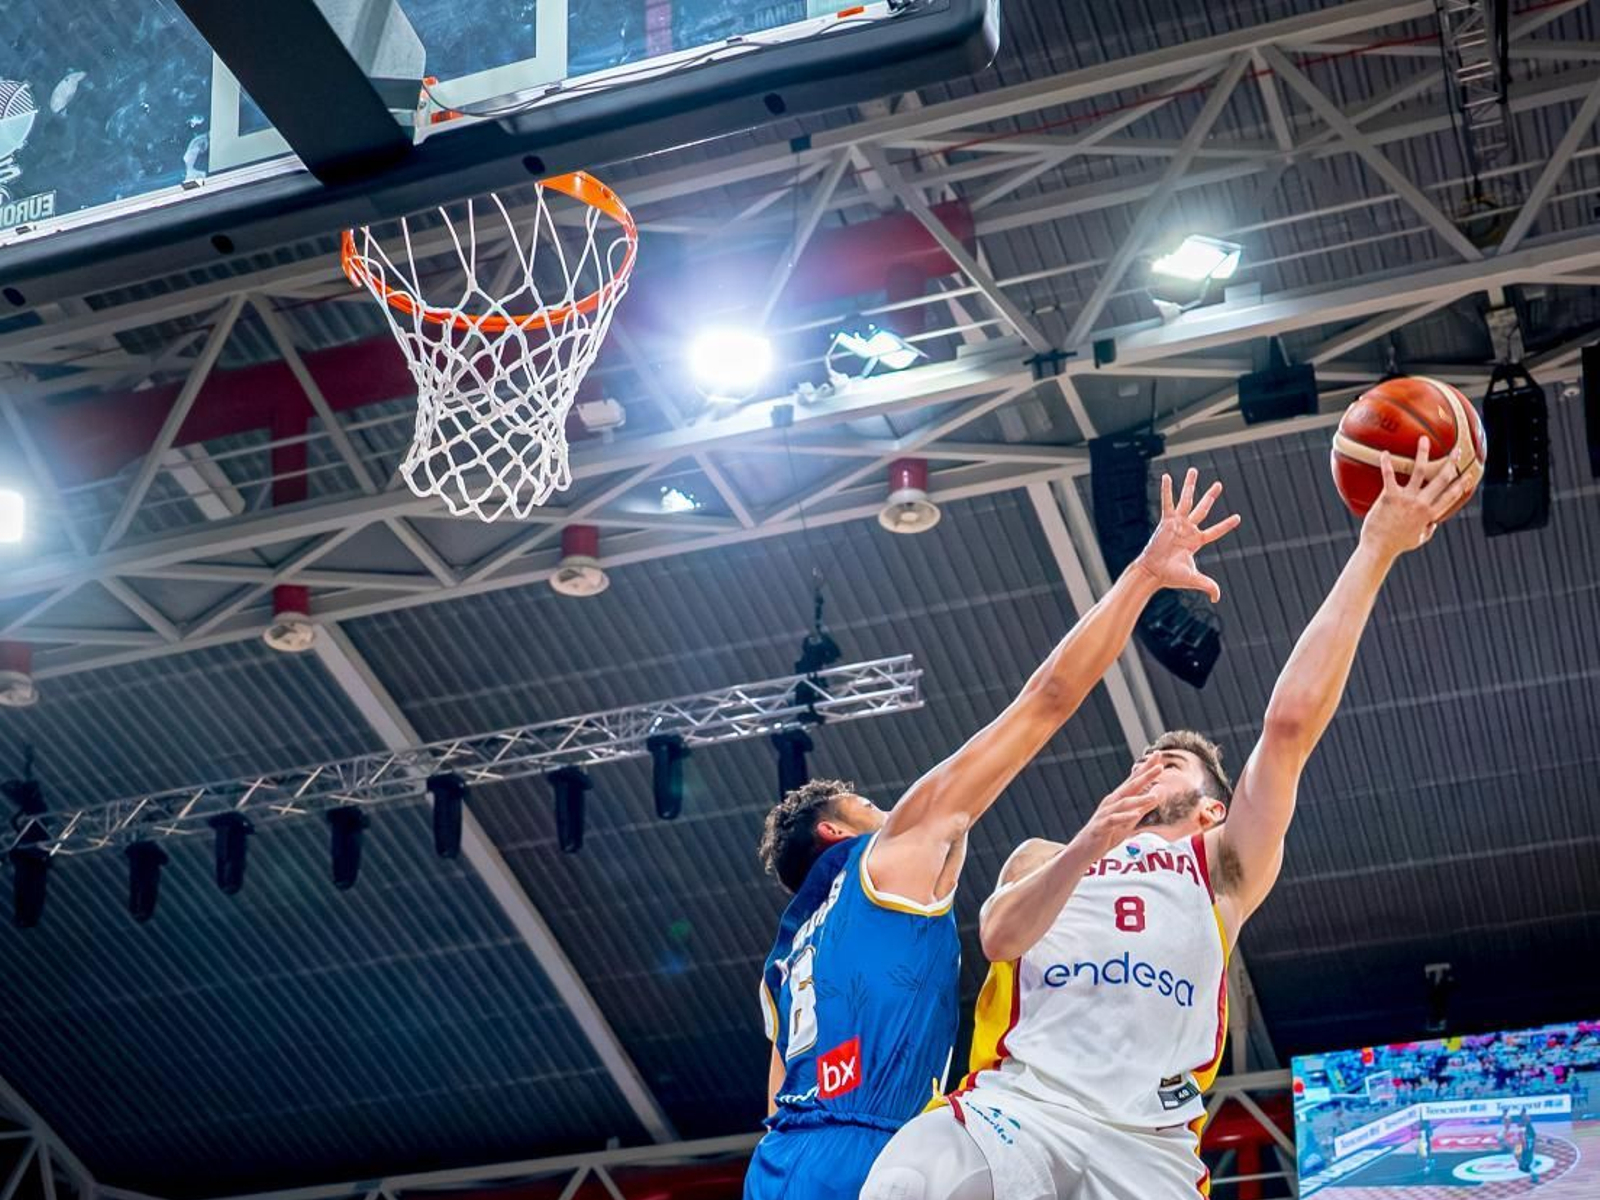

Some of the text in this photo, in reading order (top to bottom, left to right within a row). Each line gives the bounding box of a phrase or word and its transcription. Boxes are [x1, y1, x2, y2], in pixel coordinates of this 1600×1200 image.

[1084, 849, 1200, 886] SPAÑA
[1114, 896, 1146, 933] 8
[1044, 951, 1194, 1007] endesa
[822, 1056, 856, 1092] bx
